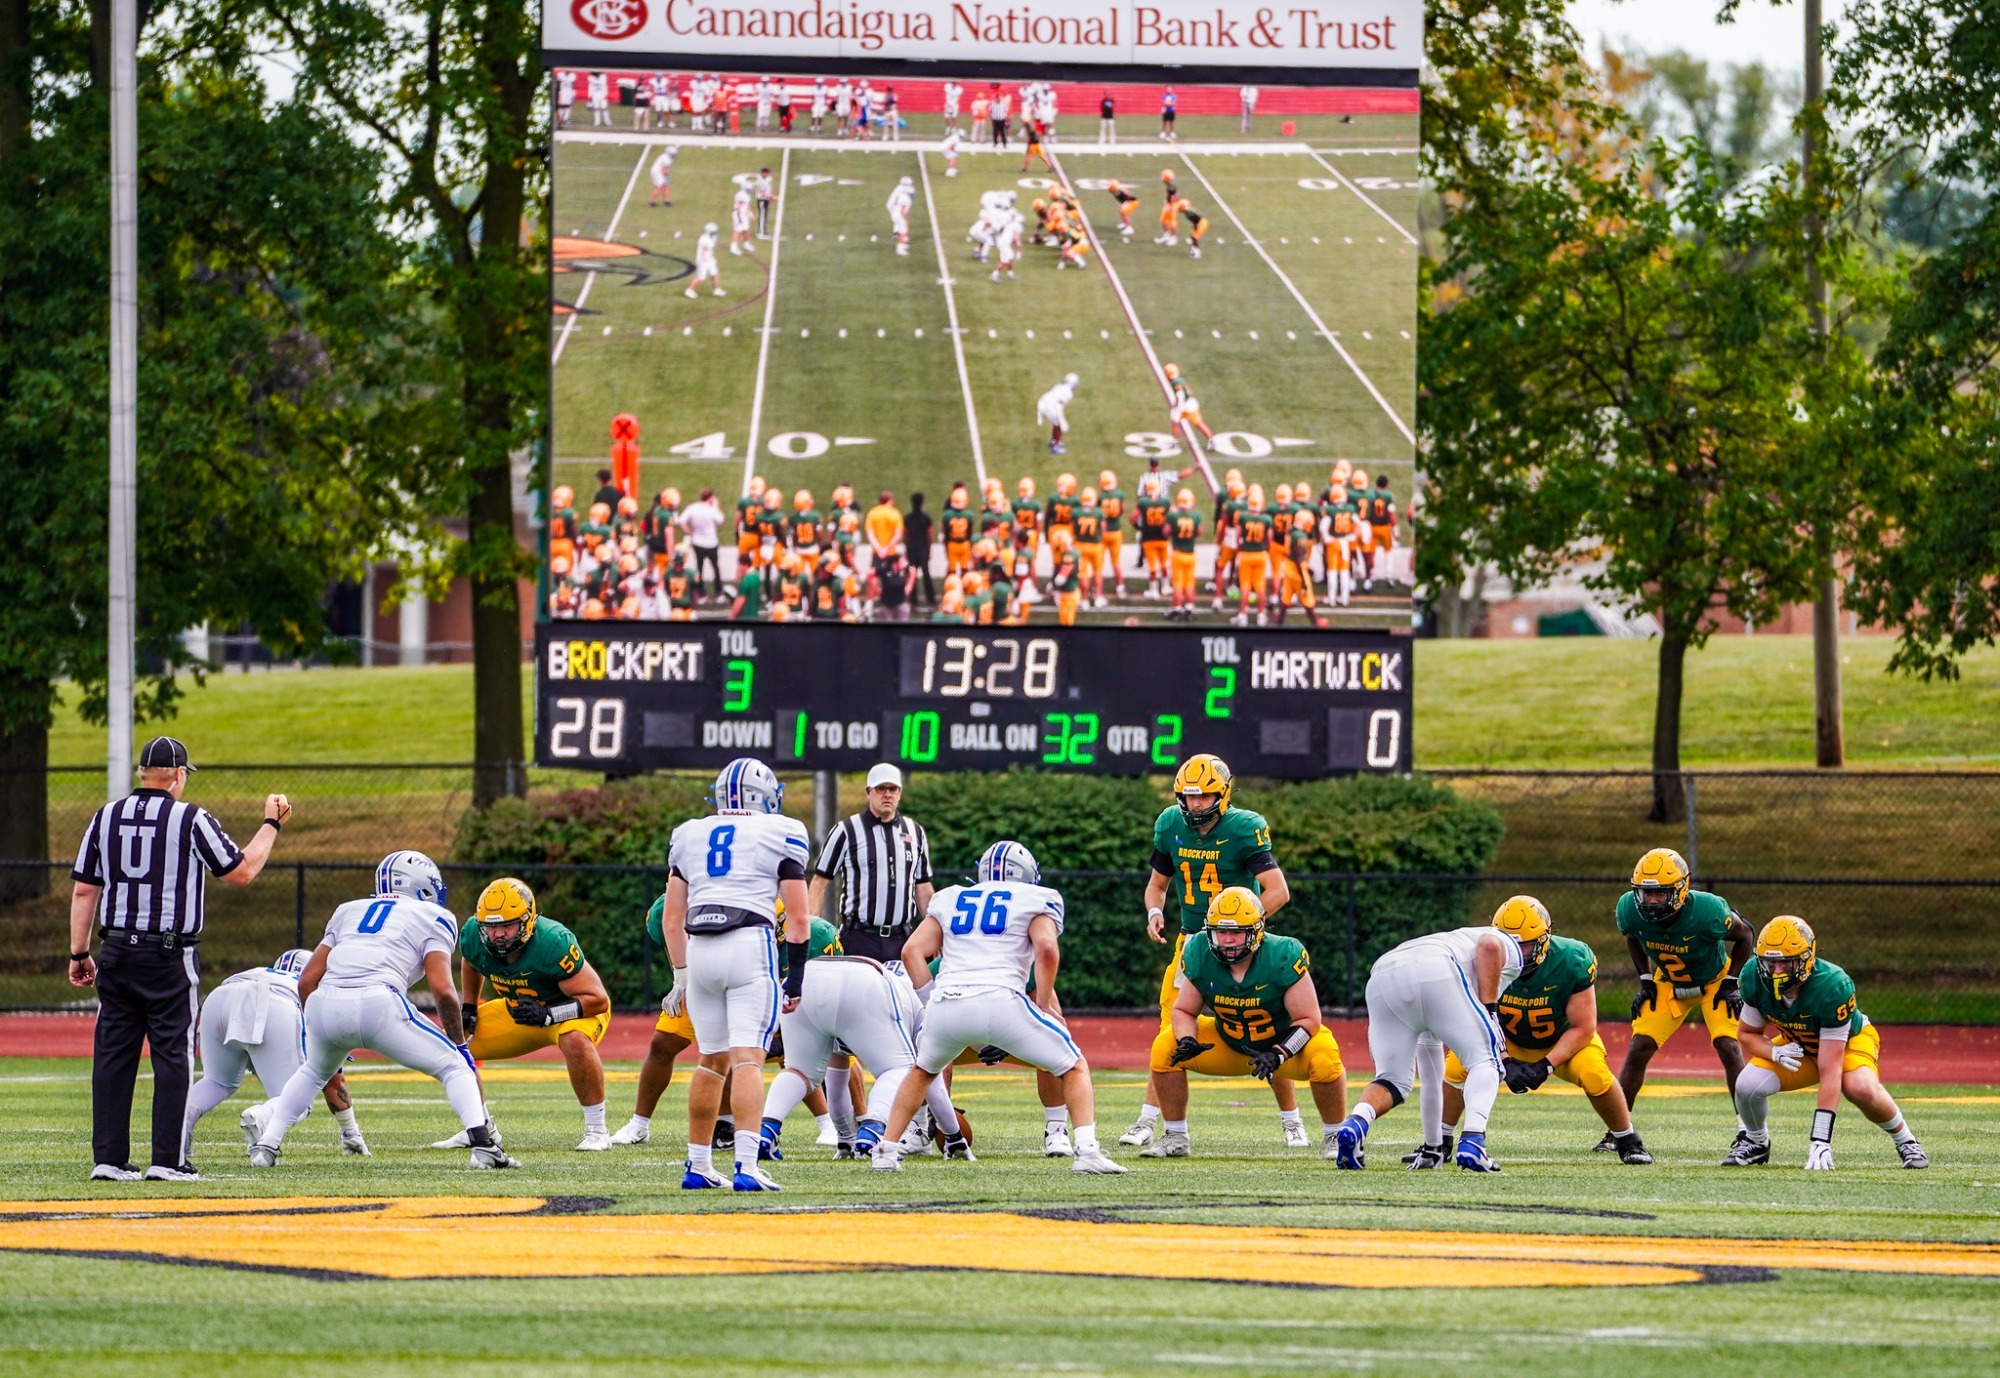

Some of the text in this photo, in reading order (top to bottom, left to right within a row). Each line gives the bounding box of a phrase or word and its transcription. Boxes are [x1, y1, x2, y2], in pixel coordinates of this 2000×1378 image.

[666, 0, 936, 50] Canandaigua
[950, 3, 1120, 45] National
[1134, 6, 1239, 48] Bank
[1248, 7, 1284, 49] &
[1288, 8, 1397, 50] Trust
[548, 641, 703, 680] BROCKPRT
[719, 630, 757, 656] TOL
[1202, 637, 1240, 663] TOL
[921, 637, 1059, 697] 13:28
[1251, 650, 1402, 690] HARTWICK
[724, 660, 755, 712] 3
[1204, 667, 1236, 718] 2
[550, 698, 625, 758] 28
[703, 721, 772, 748] DOWN
[794, 711, 808, 758] 1
[815, 722, 879, 749] TO GO
[901, 711, 941, 763] 10
[950, 724, 1037, 752] BALL ON
[1042, 712, 1099, 765] 32
[1107, 726, 1148, 753] QTR
[1151, 713, 1182, 765] 2
[1366, 709, 1401, 768] 0
[118, 825, 157, 879] U
[706, 824, 736, 877] 8
[1178, 847, 1221, 860] BROCKPORT
[1255, 825, 1272, 846] 14
[1179, 861, 1224, 908] 14
[357, 900, 397, 934] 0
[950, 890, 1013, 936] 56
[559, 944, 580, 974] 56
[1645, 941, 1690, 953] BROCKPORT
[490, 974, 529, 987] BROCKPORT
[1658, 953, 1693, 982] 2
[1214, 995, 1261, 1007] BROCKPORT
[1502, 994, 1550, 1007] BROCKPORT
[1213, 1005, 1277, 1042] 52
[1498, 1004, 1556, 1040] 75
